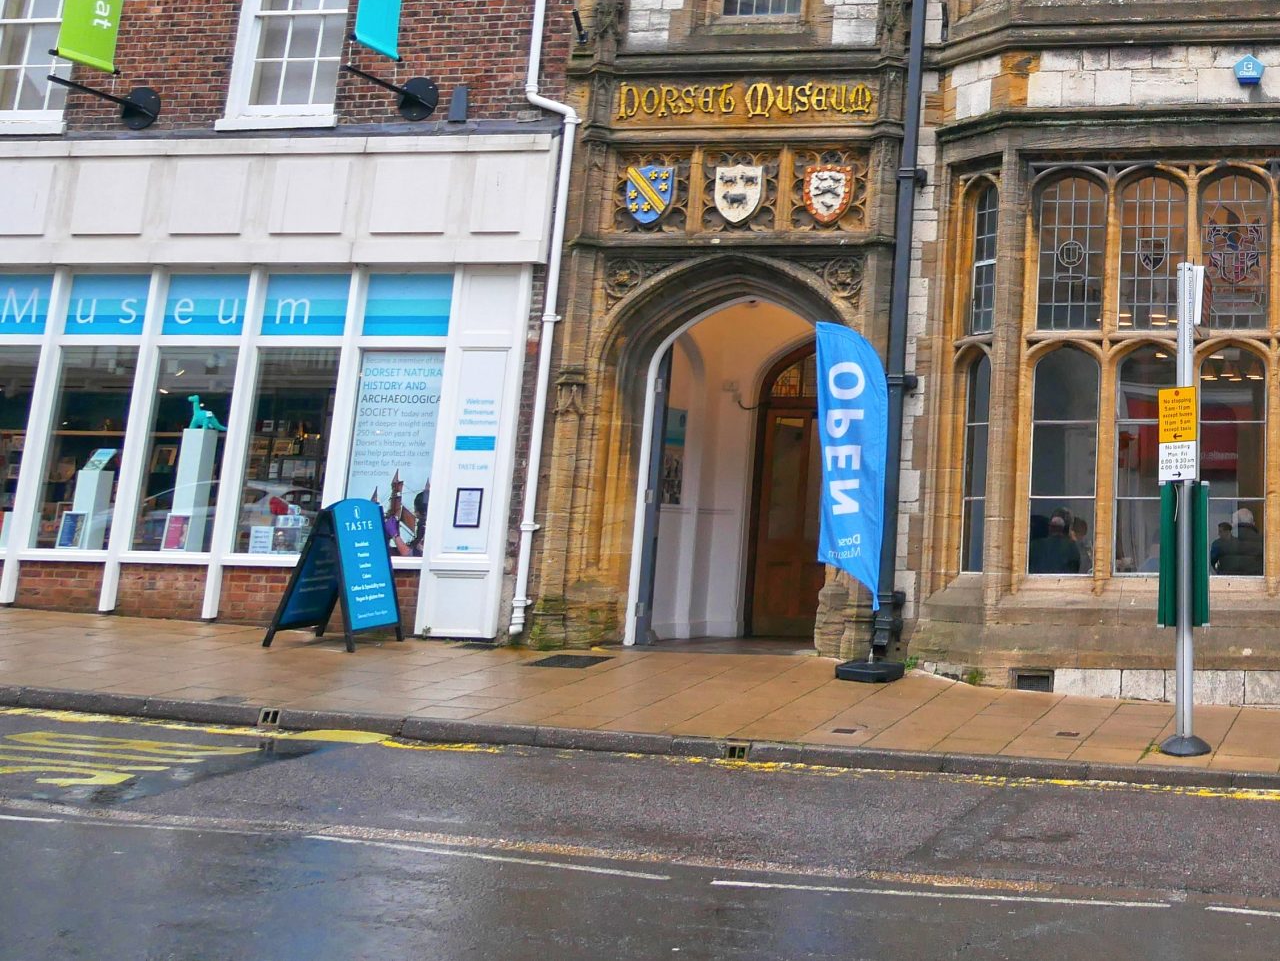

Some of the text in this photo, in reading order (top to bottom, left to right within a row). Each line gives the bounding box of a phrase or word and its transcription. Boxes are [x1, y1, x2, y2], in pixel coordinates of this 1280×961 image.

[1, 287, 311, 325] Museum
[397, 356, 424, 364] member
[364, 367, 400, 377] DORSET
[363, 381, 426, 390] HISTORY AND
[359, 407, 399, 417] SOCIETY
[357, 420, 369, 428] get
[374, 420, 397, 428] deeper
[398, 420, 420, 428] insight
[393, 430, 411, 438] years
[354, 450, 366, 458] you
[367, 449, 381, 458] help
[382, 449, 406, 458] protect
[353, 460, 379, 468] heritage
[345, 520, 373, 531] TASTE
